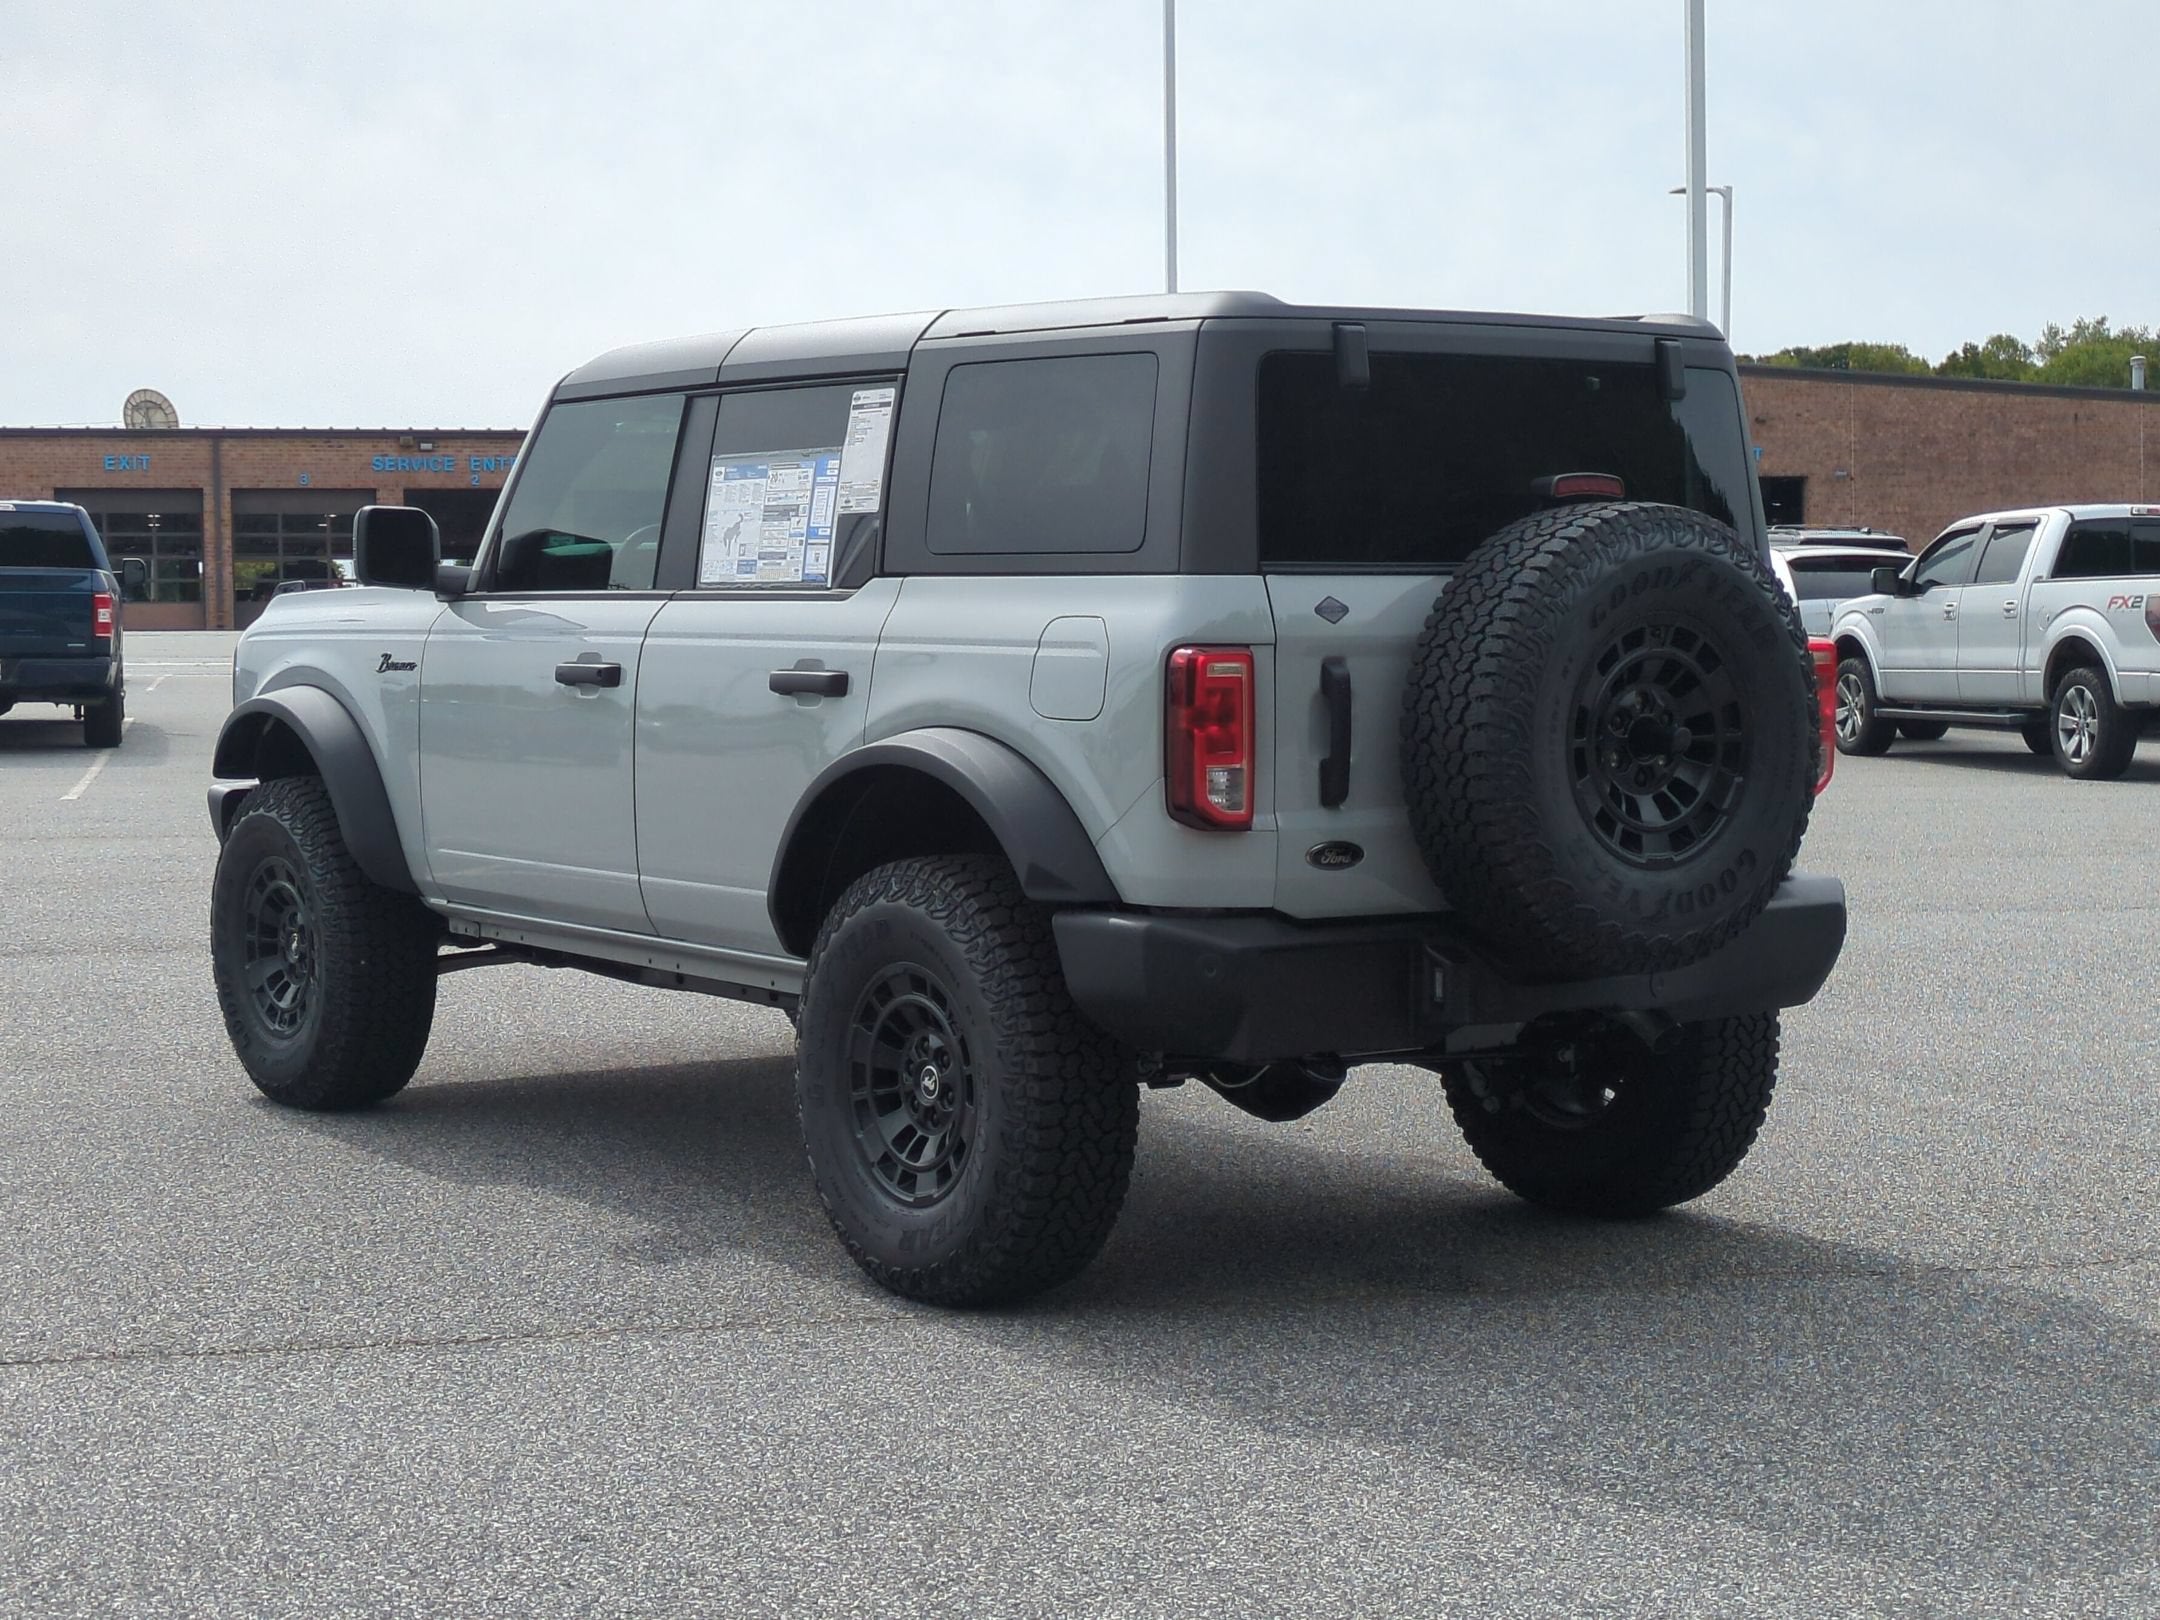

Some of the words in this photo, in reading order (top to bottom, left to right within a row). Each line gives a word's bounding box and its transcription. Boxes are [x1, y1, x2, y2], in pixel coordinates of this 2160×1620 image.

[104, 455, 150, 471] EXIT
[372, 456, 454, 471] SERVICE
[300, 473, 309, 485] 3
[471, 475, 479, 487] 2
[2107, 595, 2144, 609] FX2
